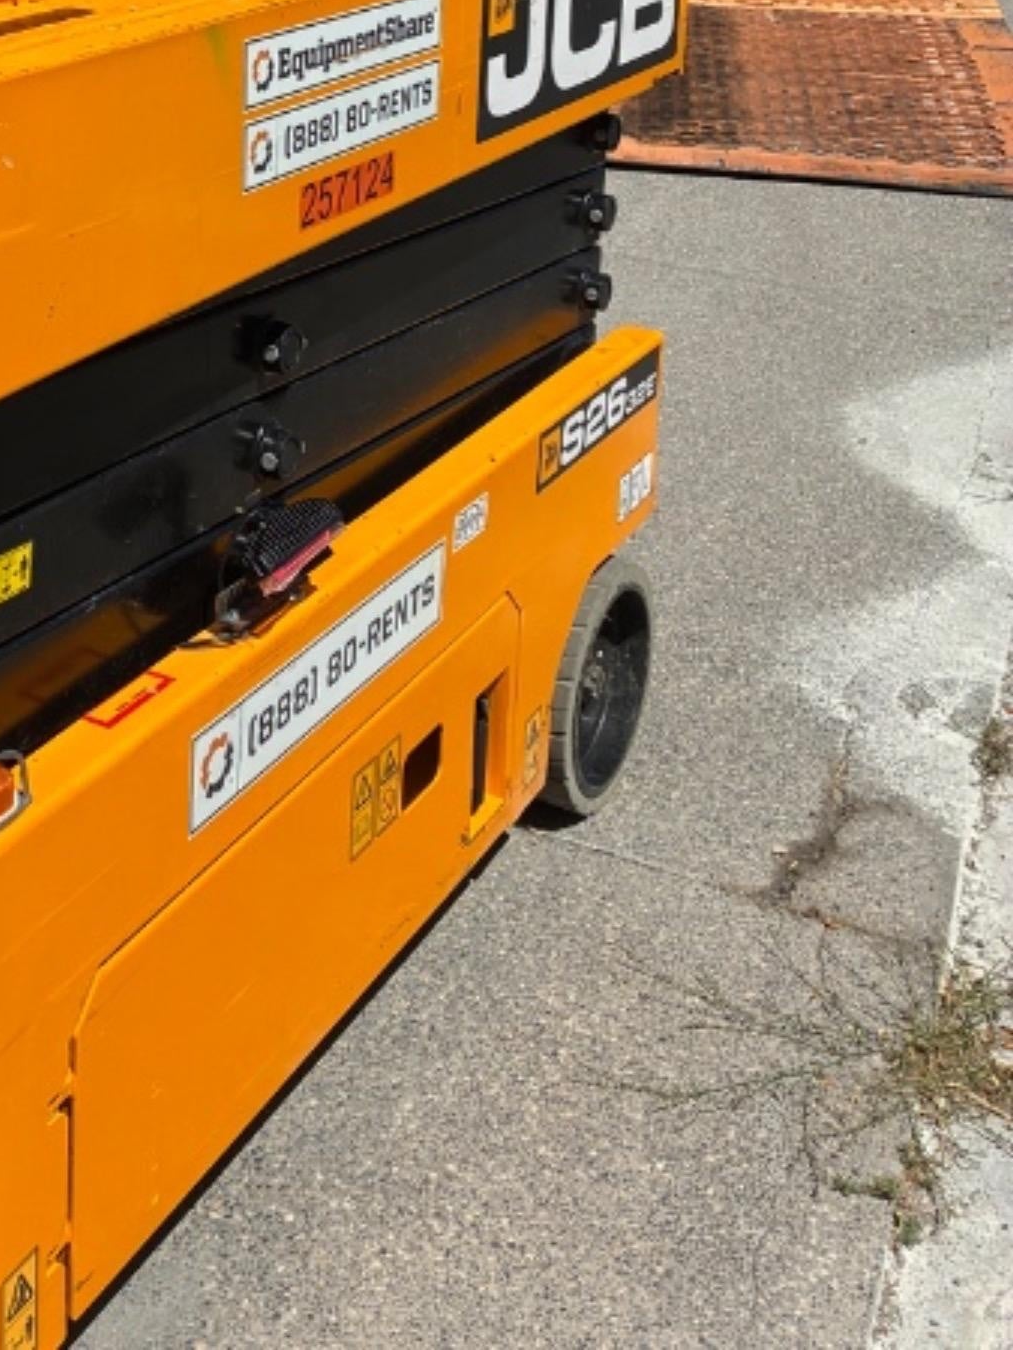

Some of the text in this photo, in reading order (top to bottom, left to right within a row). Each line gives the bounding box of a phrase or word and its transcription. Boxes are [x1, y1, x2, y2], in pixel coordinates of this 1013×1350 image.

[277, 10, 436, 81] EquipmentShare
[284, 109, 340, 159] (888)
[301, 151, 395, 229] 257124
[248, 665, 318, 757] (888)
